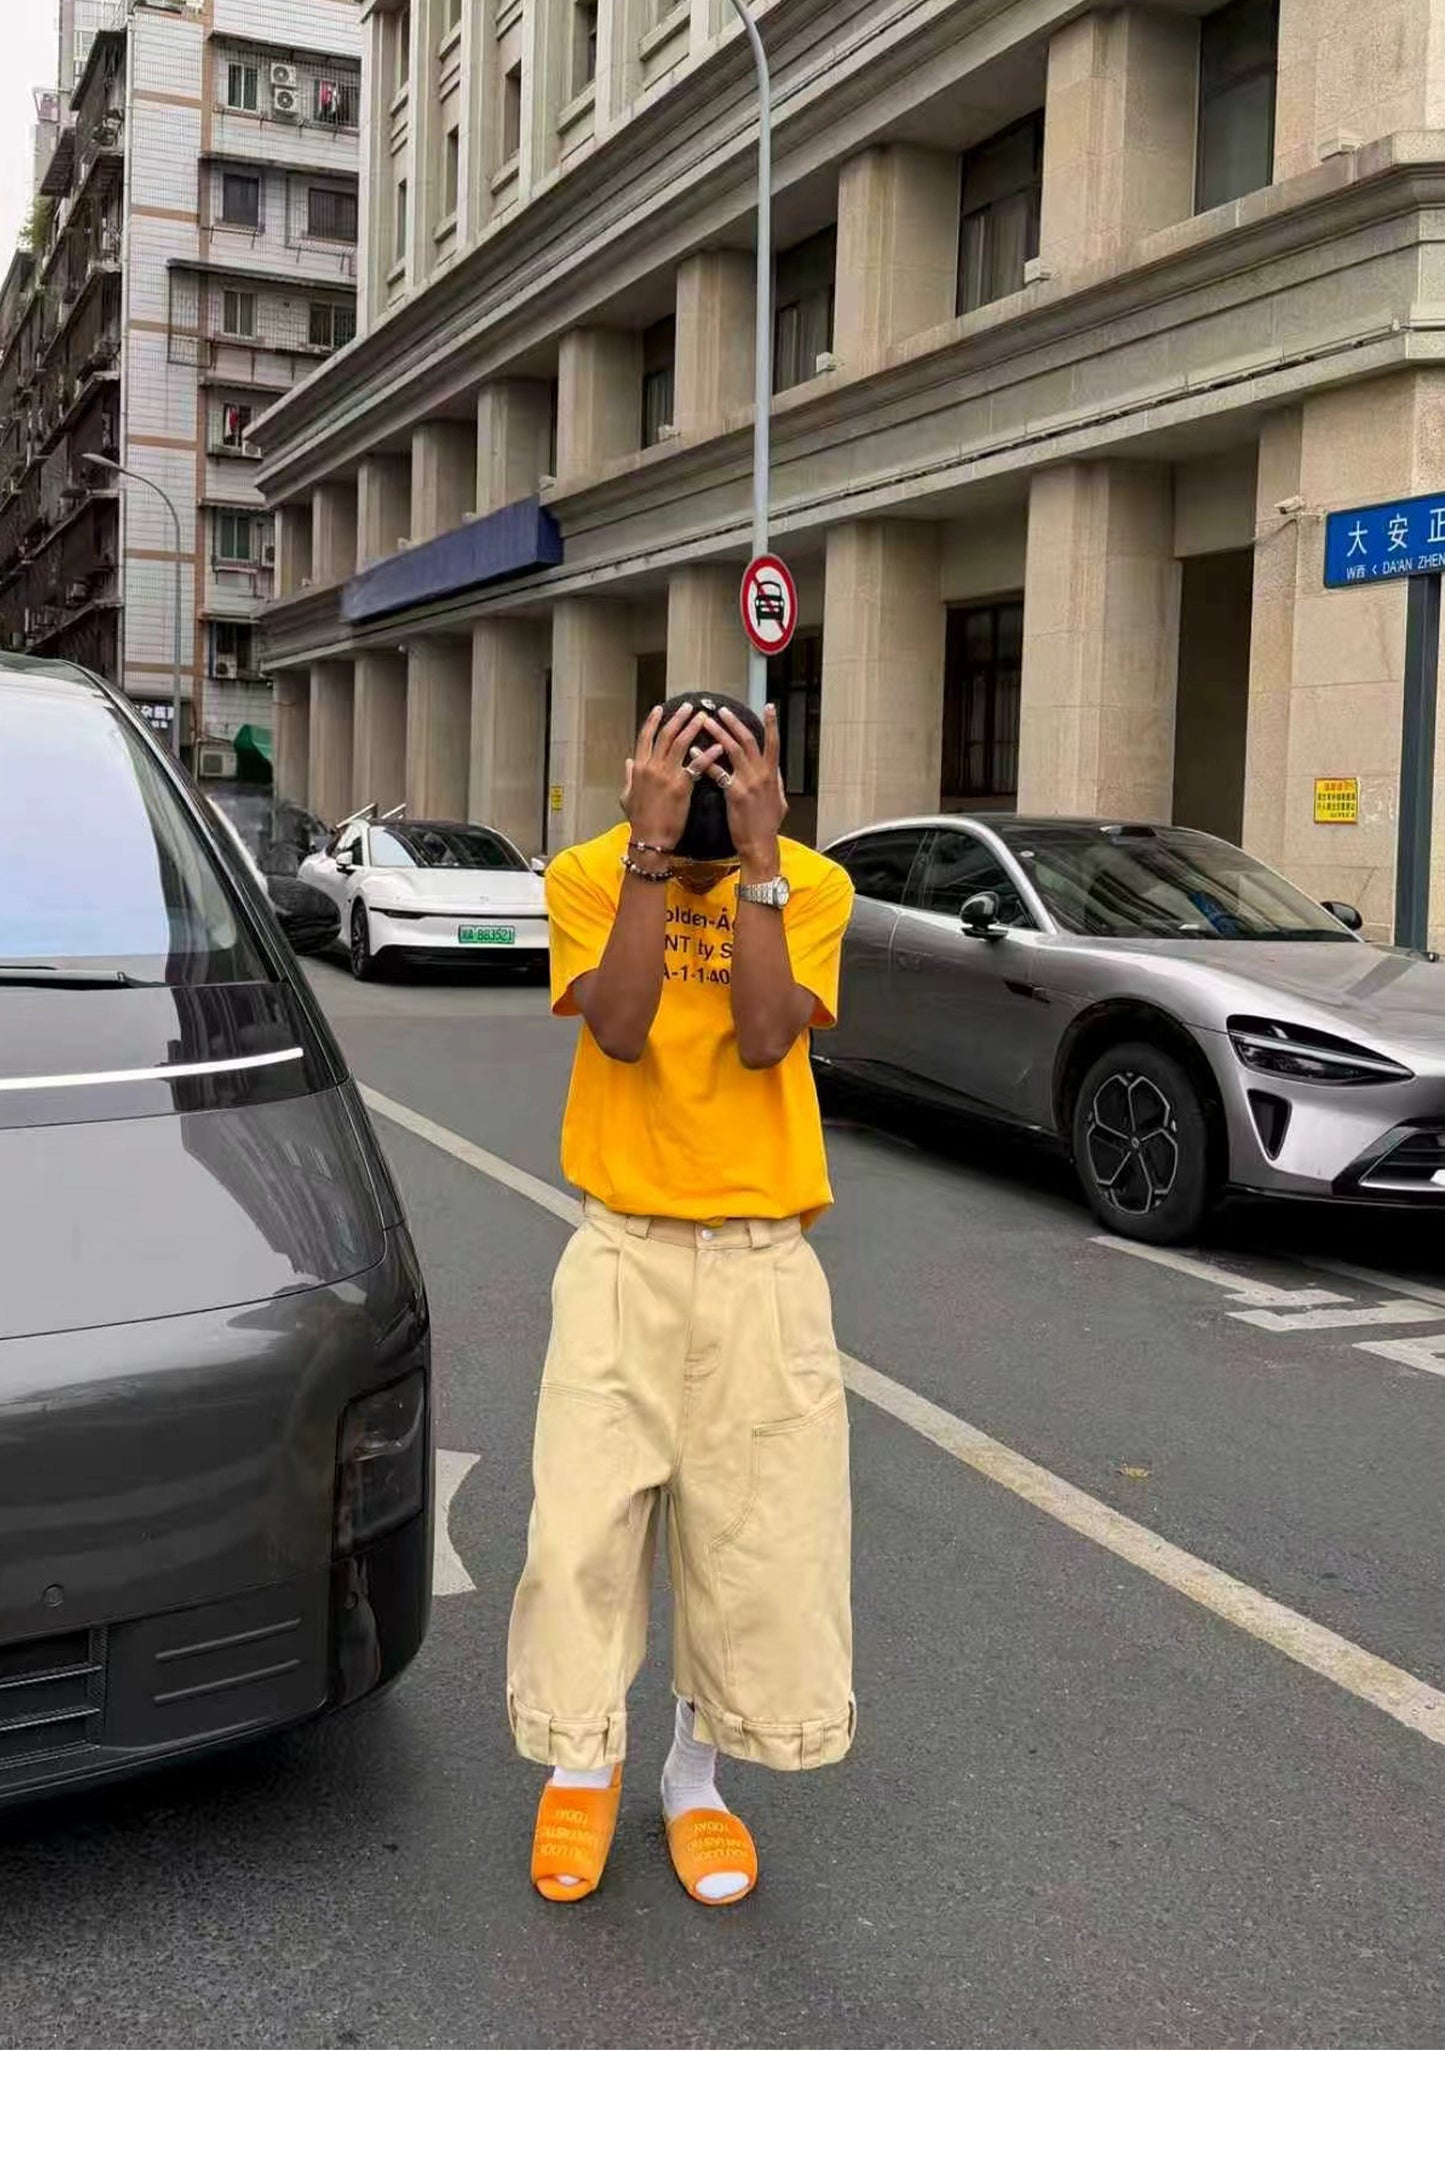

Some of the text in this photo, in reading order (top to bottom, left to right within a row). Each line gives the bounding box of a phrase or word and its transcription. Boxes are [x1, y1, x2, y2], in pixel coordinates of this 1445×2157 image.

[1346, 507, 1445, 557] 大安正
[665, 906, 735, 932] olden-Å
